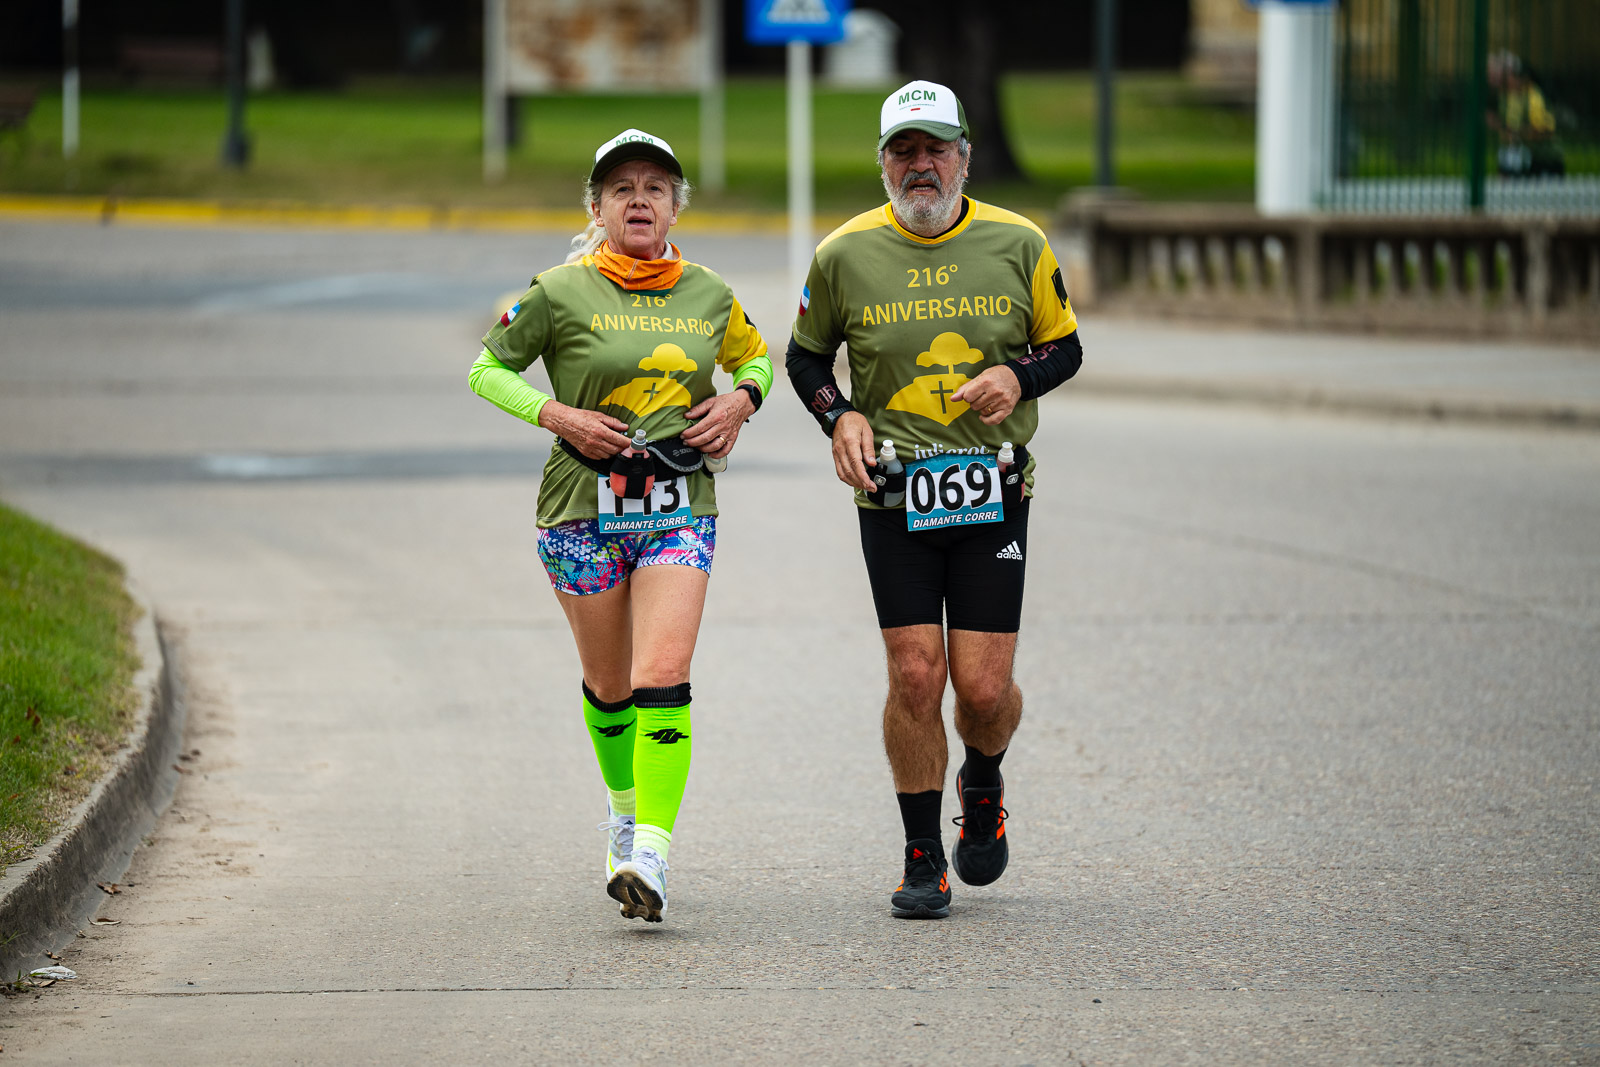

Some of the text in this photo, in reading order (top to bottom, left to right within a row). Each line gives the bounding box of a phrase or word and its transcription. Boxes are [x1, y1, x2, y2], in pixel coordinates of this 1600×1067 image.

[898, 89, 937, 105] MCM
[906, 264, 958, 288] 216°
[862, 295, 1012, 327] ANIVERSARIO
[590, 313, 715, 337] ANIVERSARIO
[910, 461, 992, 516] 069
[603, 515, 688, 531] DIAMANTE CORRE
[912, 510, 999, 529] DIAMANTE CORRE
